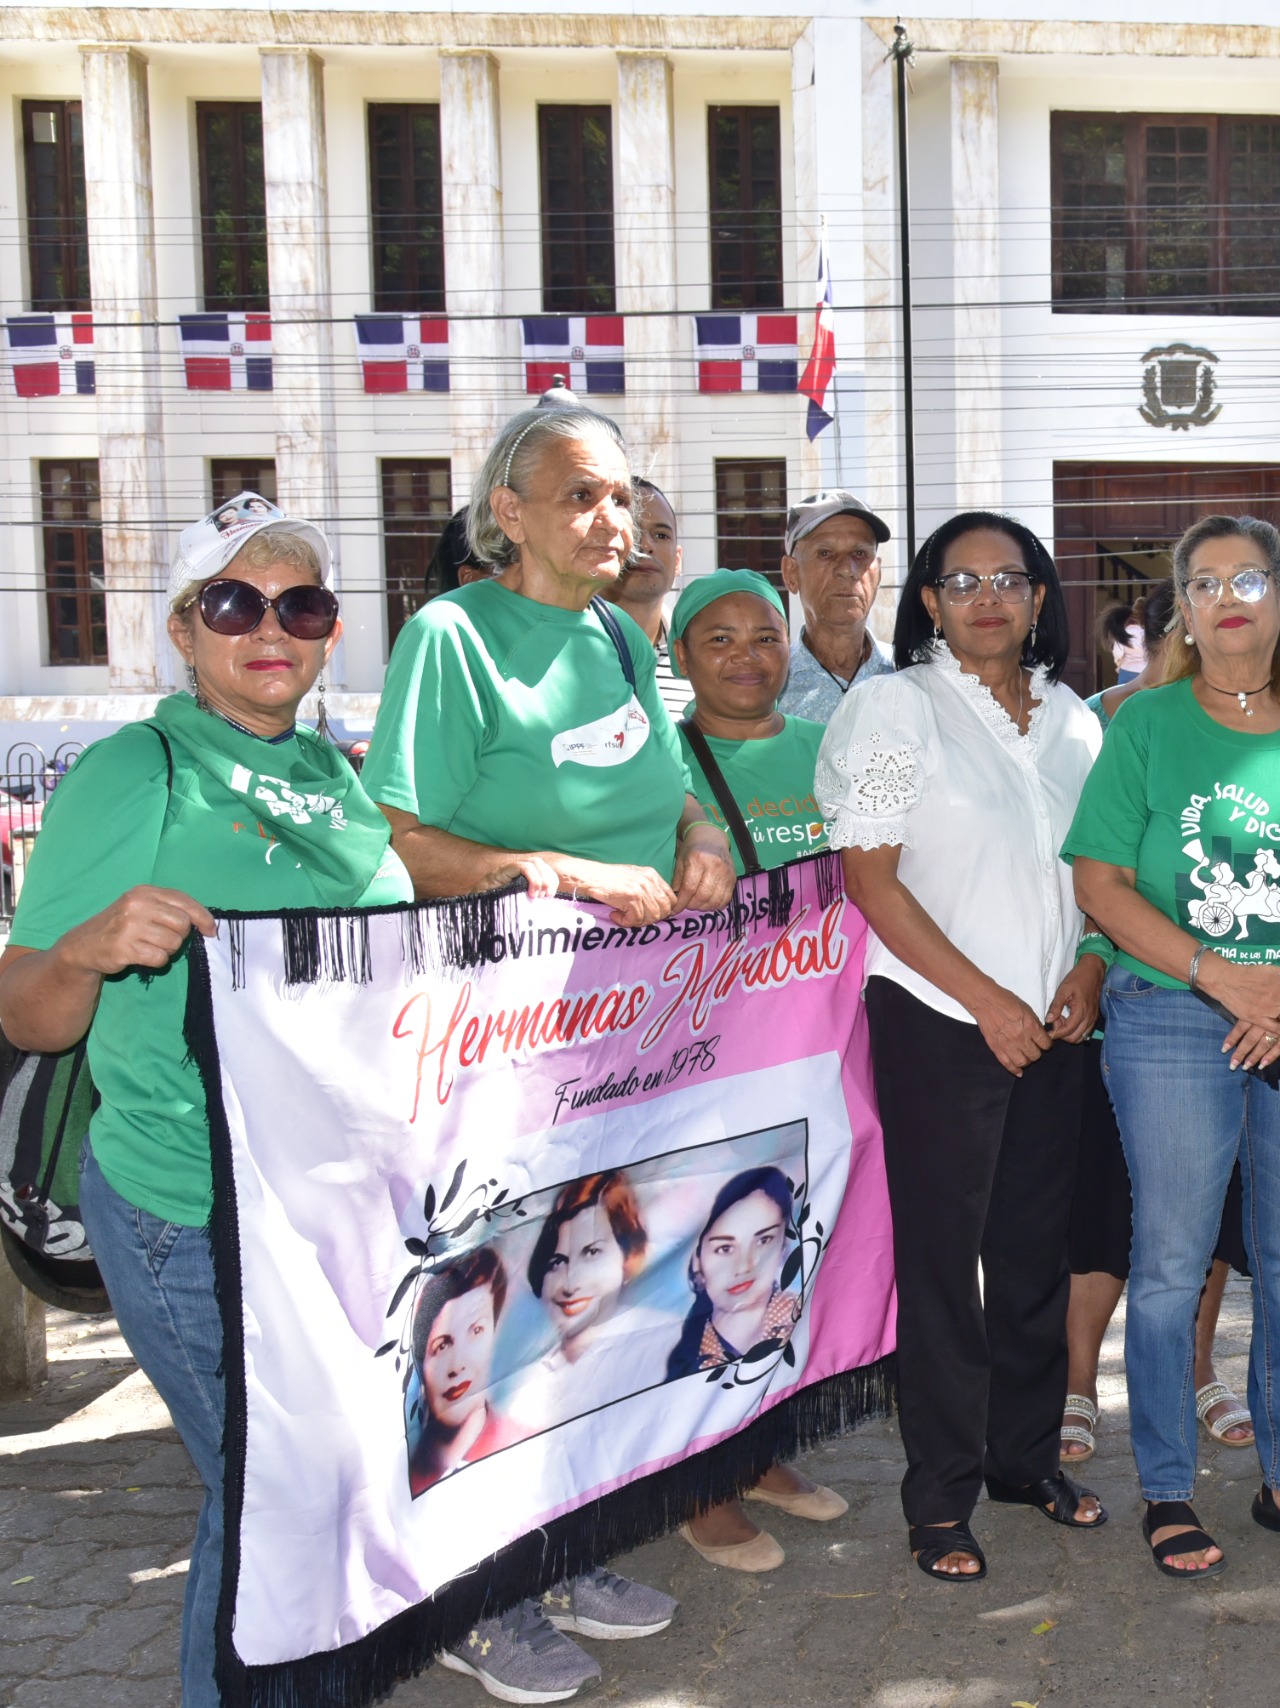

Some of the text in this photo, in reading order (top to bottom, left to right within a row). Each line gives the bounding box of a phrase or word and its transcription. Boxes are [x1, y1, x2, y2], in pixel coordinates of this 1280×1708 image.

[1213, 782, 1270, 816] SALUD
[1229, 806, 1246, 822] Y
[471, 889, 795, 967] ovimiento Feminis
[393, 899, 846, 1123] Hermanas Mirabal
[552, 1035, 721, 1125] Fundado en 1978
